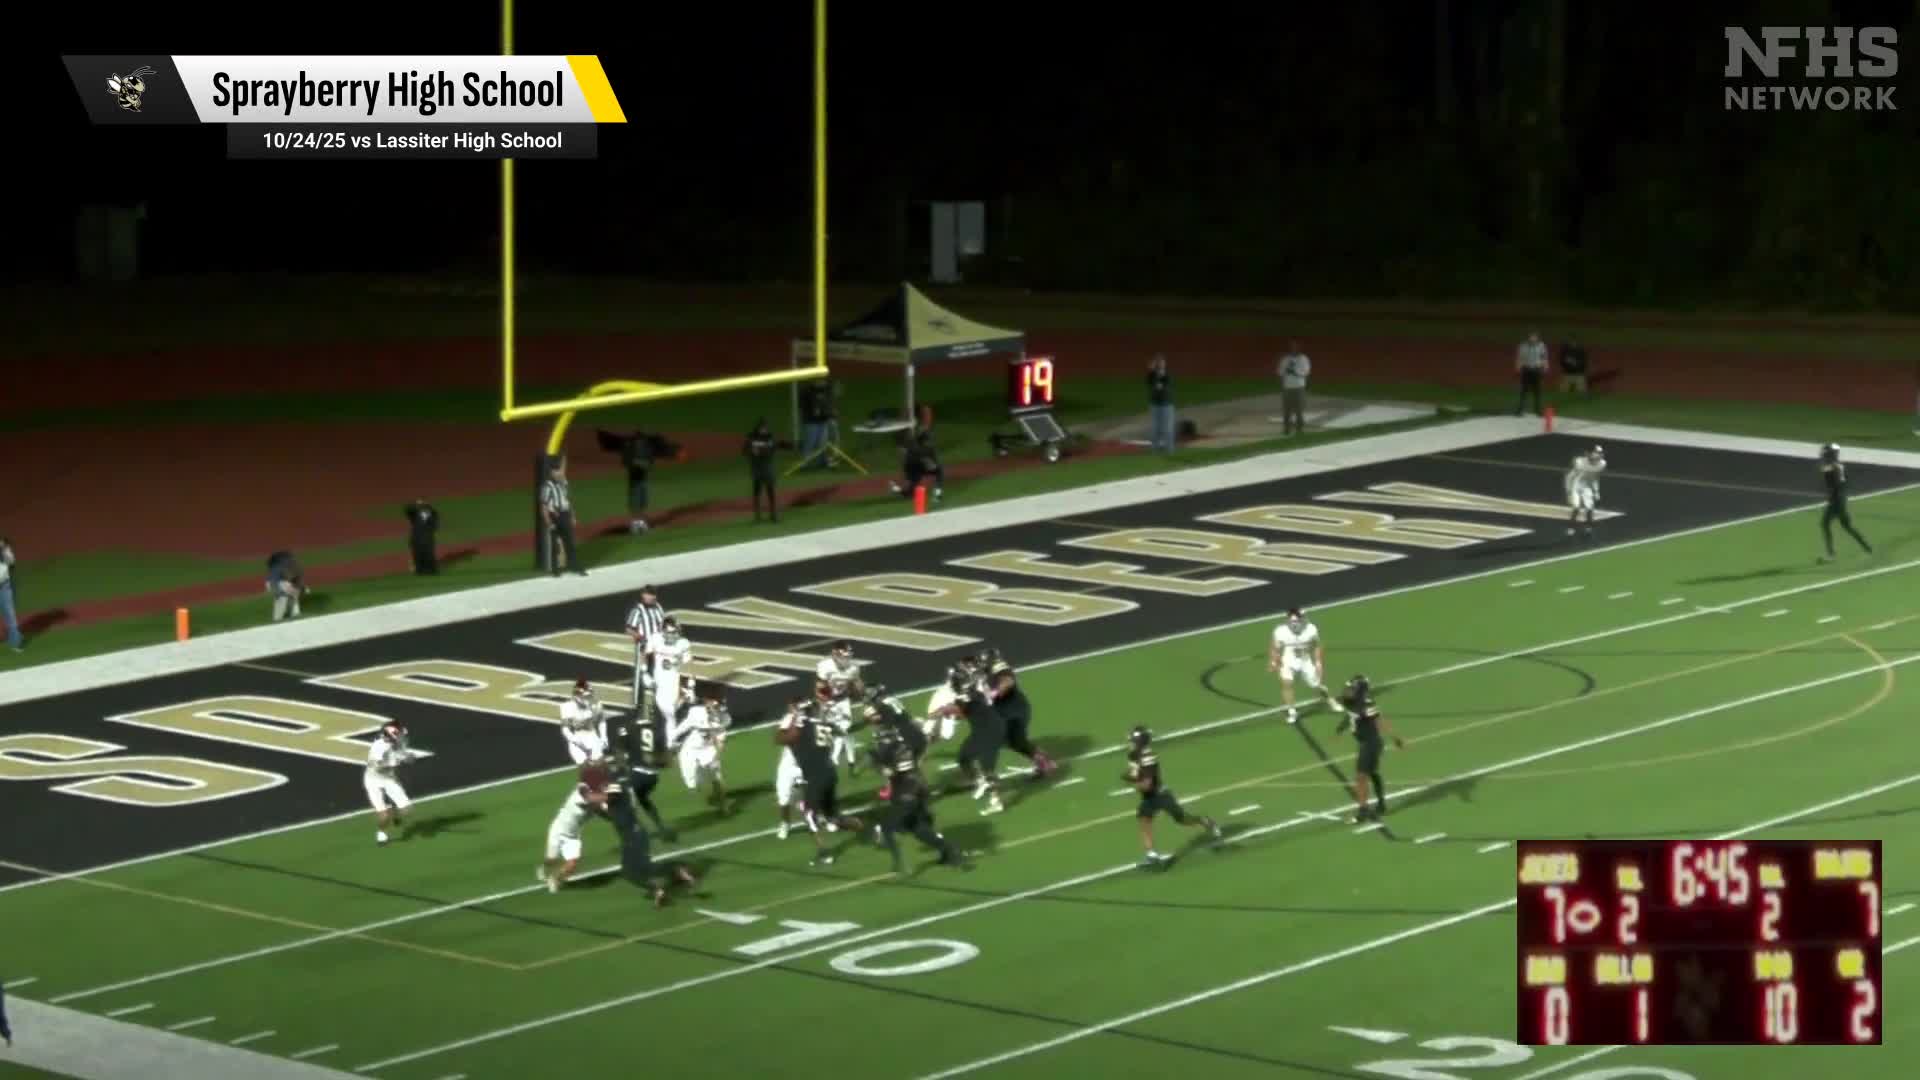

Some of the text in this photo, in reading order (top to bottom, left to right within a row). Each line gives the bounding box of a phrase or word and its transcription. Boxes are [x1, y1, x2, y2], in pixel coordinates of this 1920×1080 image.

[1021, 358, 1053, 406] 19
[641, 728, 654, 752] 9
[732, 919, 981, 977] 10
